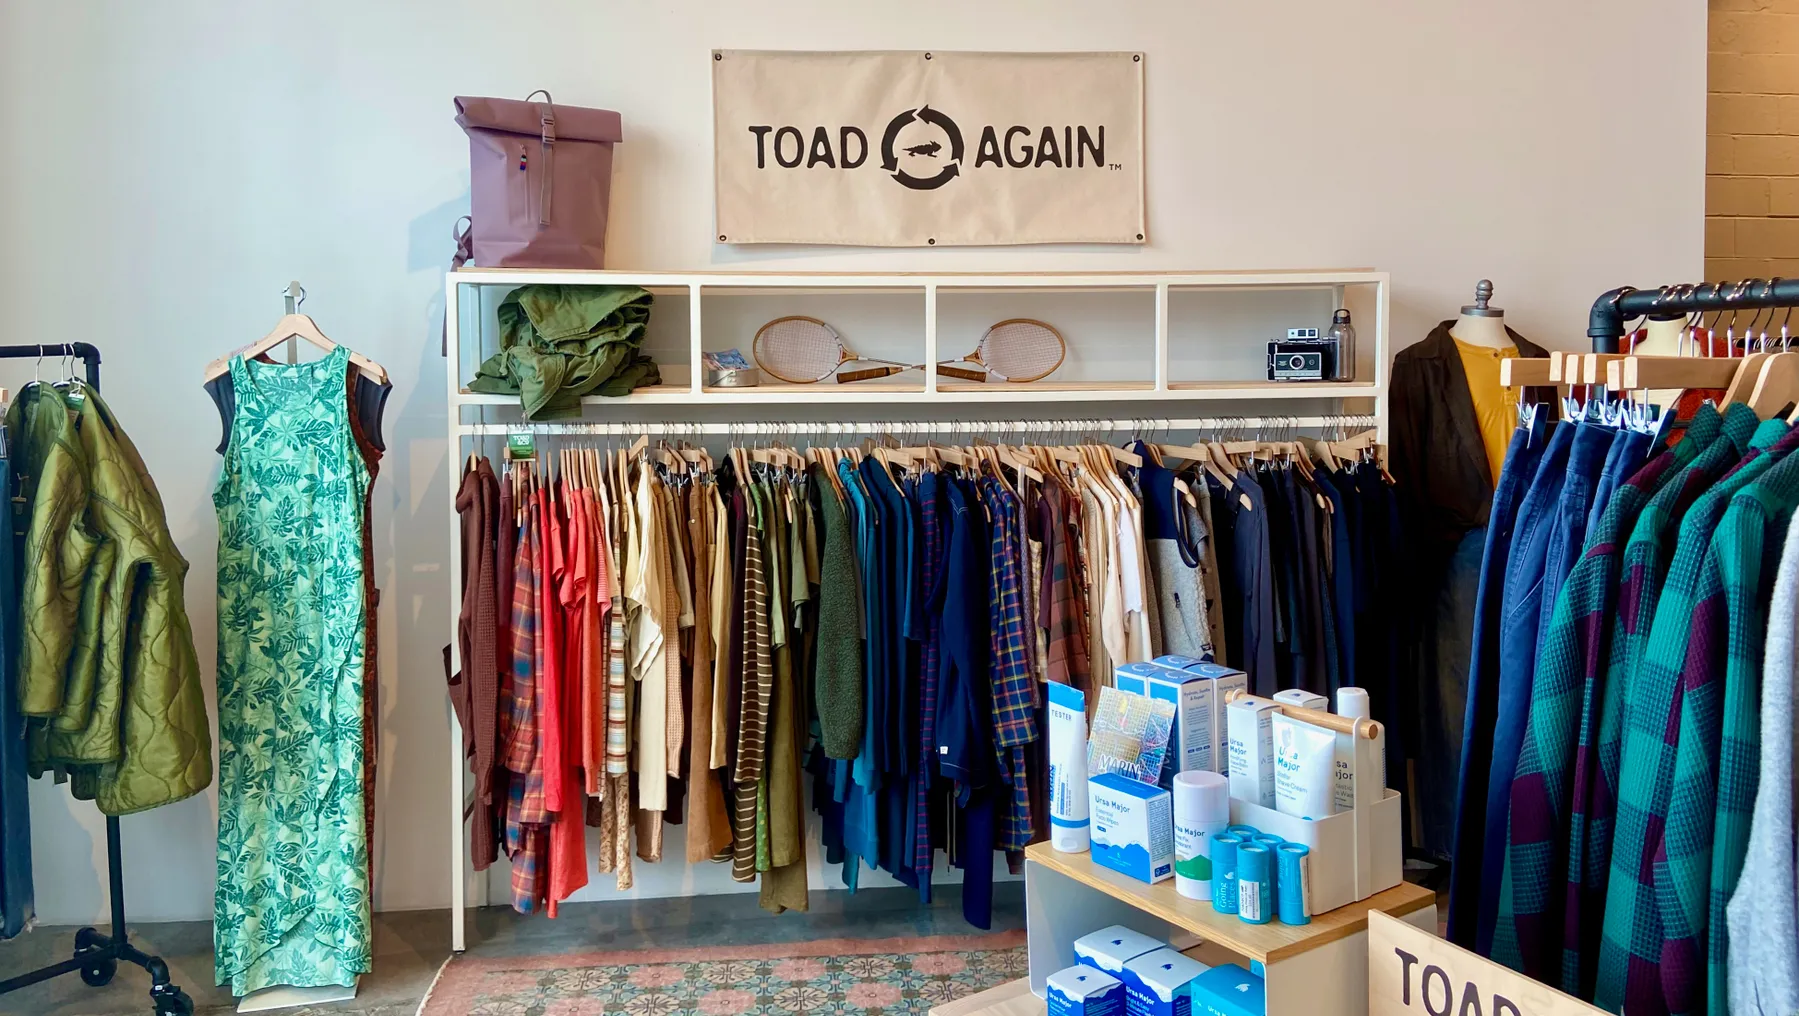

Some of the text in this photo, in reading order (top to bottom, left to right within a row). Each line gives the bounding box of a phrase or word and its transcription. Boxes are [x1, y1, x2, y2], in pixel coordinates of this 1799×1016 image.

[749, 126, 869, 169] TOAD
[975, 126, 1105, 169] AGAIN
[1051, 709, 1072, 721] TESTER
[1230, 738, 1244, 747] Ursa
[1230, 745, 1247, 755] Major
[1279, 747, 1299, 760] Ua
[1098, 754, 1140, 780] MARIN
[1277, 757, 1301, 772] Major
[1336, 760, 1348, 769] sa
[1335, 769, 1353, 780] jor
[1290, 782, 1308, 794] Cream
[1094, 795, 1130, 813] Ursa Major
[1175, 825, 1183, 833] rsa
[1184, 828, 1205, 837] Major
[1228, 881, 1236, 908] Places
[1049, 991, 1059, 1002] Ursa
[1059, 997, 1072, 1008] Major
[1126, 985, 1155, 1006] Ursa Major
[1207, 1005, 1221, 1016] Ursa
